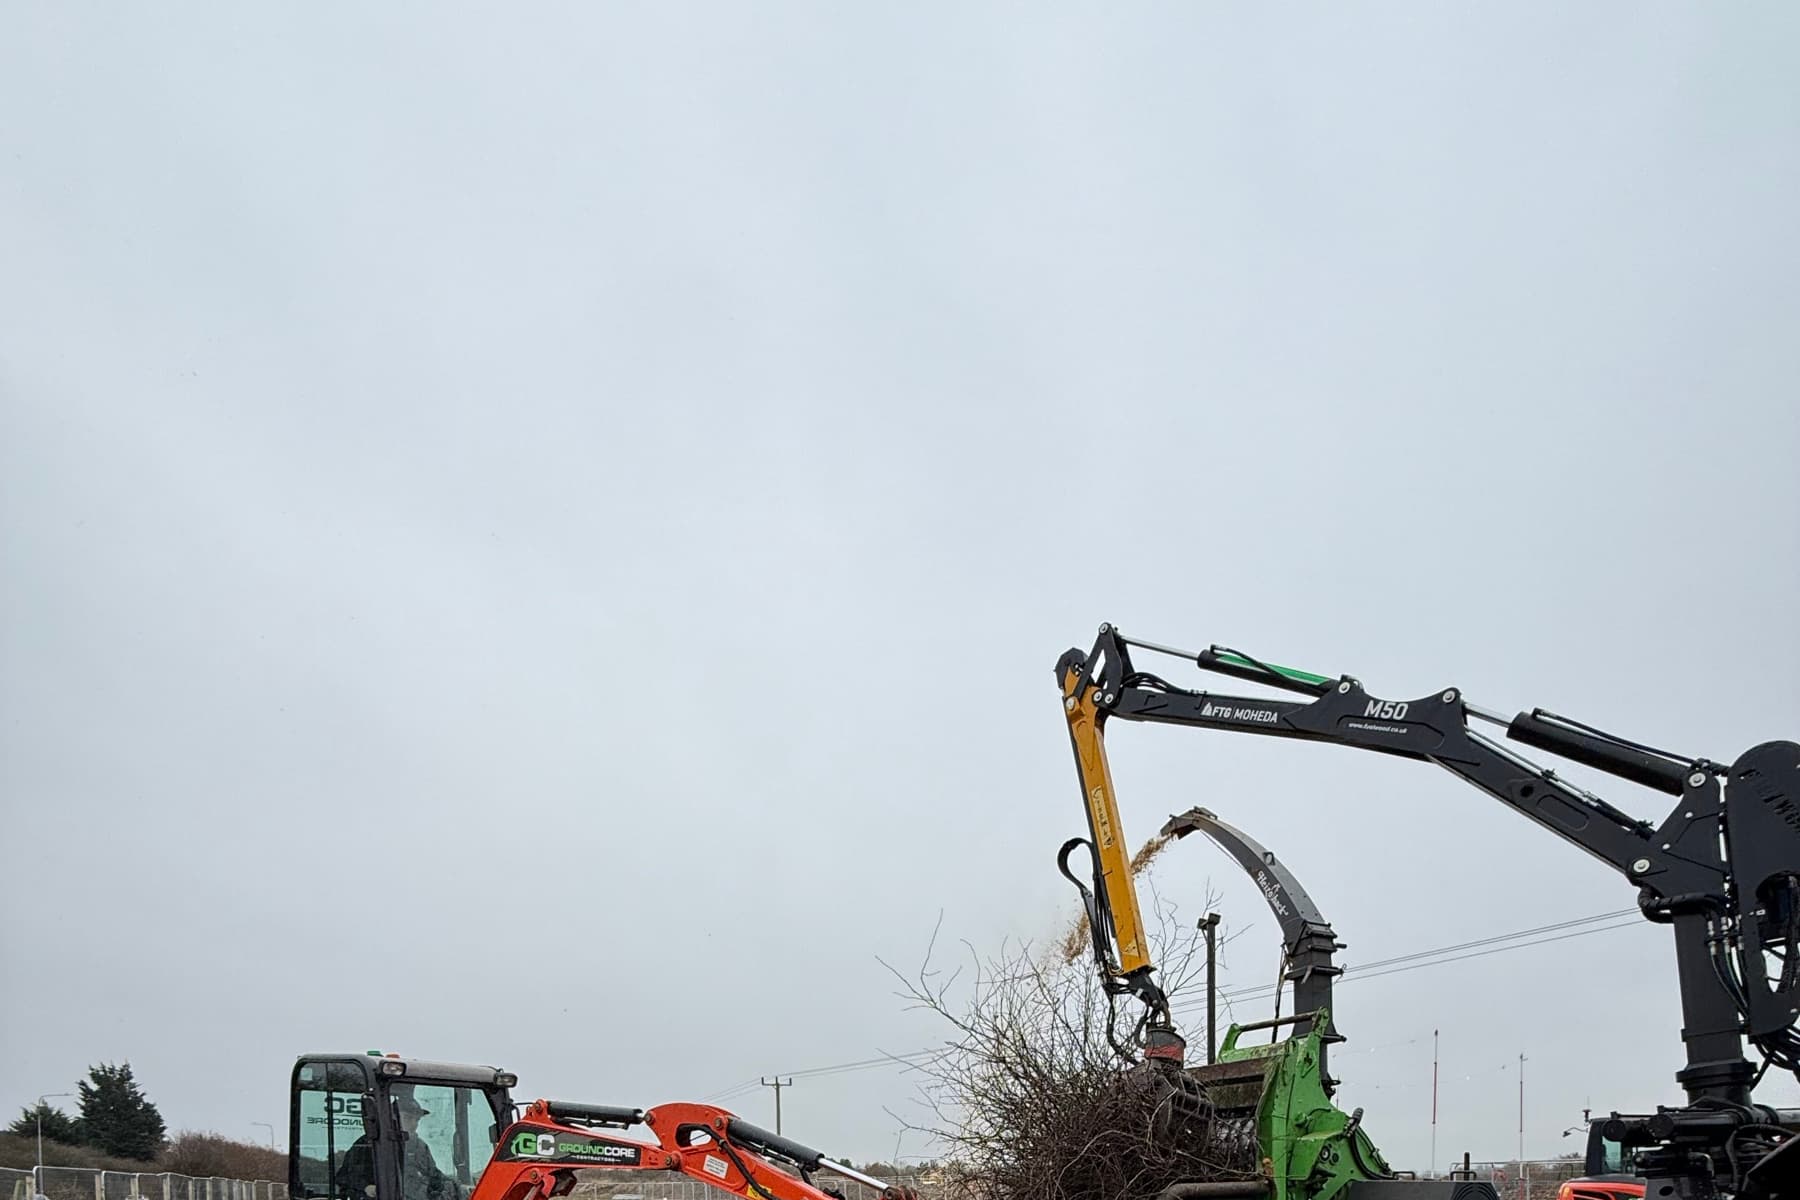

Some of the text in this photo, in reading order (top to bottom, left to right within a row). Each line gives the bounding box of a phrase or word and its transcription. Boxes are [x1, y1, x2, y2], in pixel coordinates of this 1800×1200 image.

[1212, 706, 1278, 723] FTG MOHEDA
[1363, 700, 1409, 720] M50
[514, 1133, 636, 1158] GC GROUNDCORE
